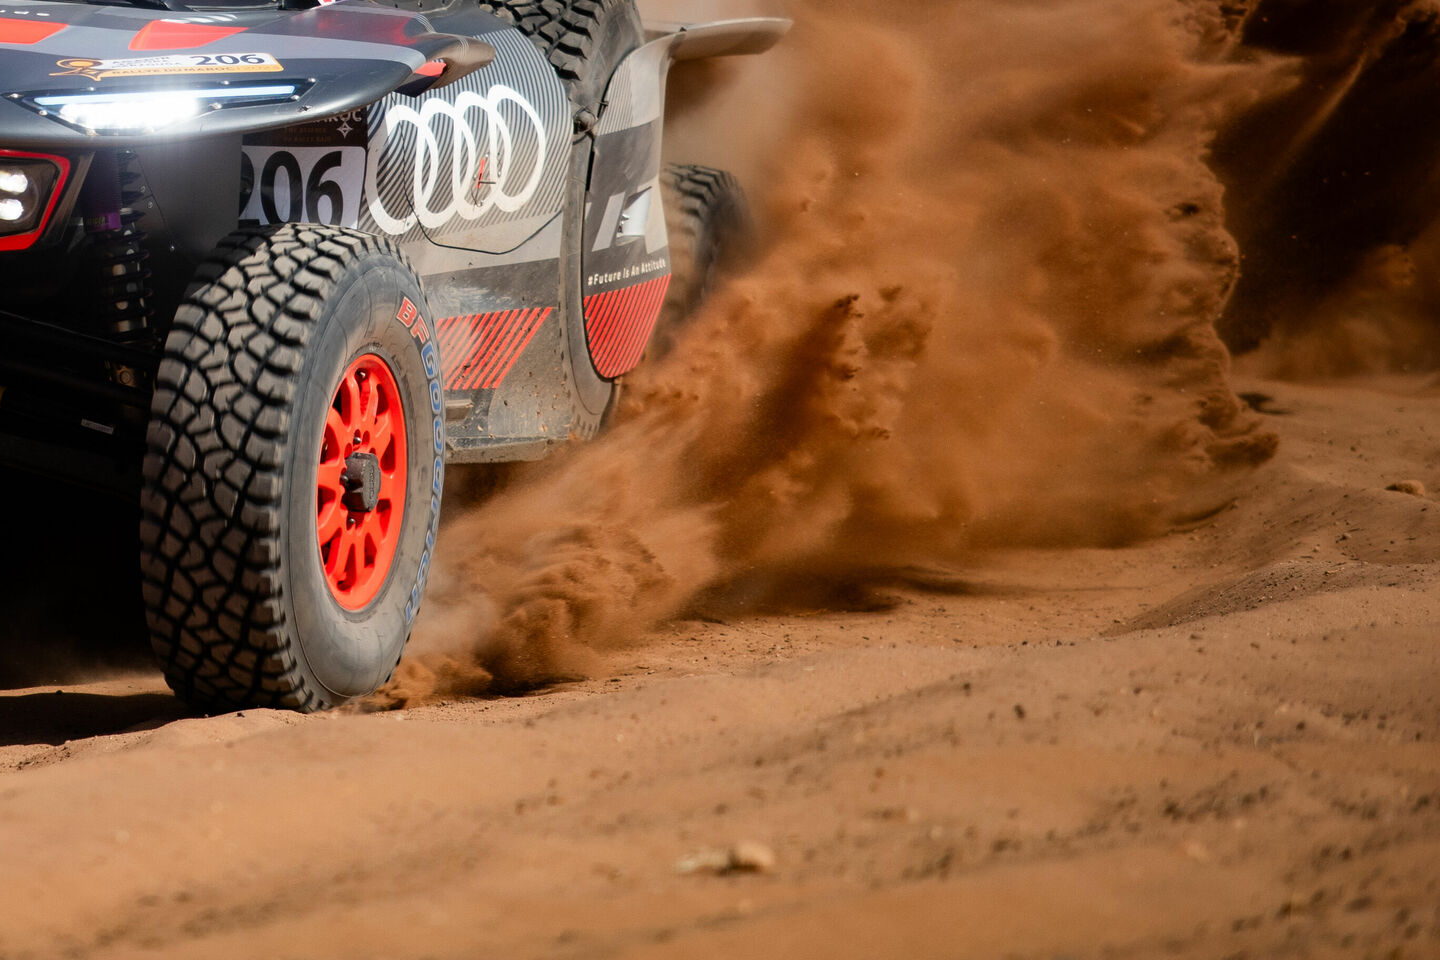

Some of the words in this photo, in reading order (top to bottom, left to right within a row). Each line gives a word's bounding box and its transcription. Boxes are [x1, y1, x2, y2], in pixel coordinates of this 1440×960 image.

[189, 53, 266, 66] 206
[587, 272, 622, 286] #Future
[623, 267, 630, 279] Is
[631, 265, 640, 277] An
[641, 257, 666, 274] Attitude
